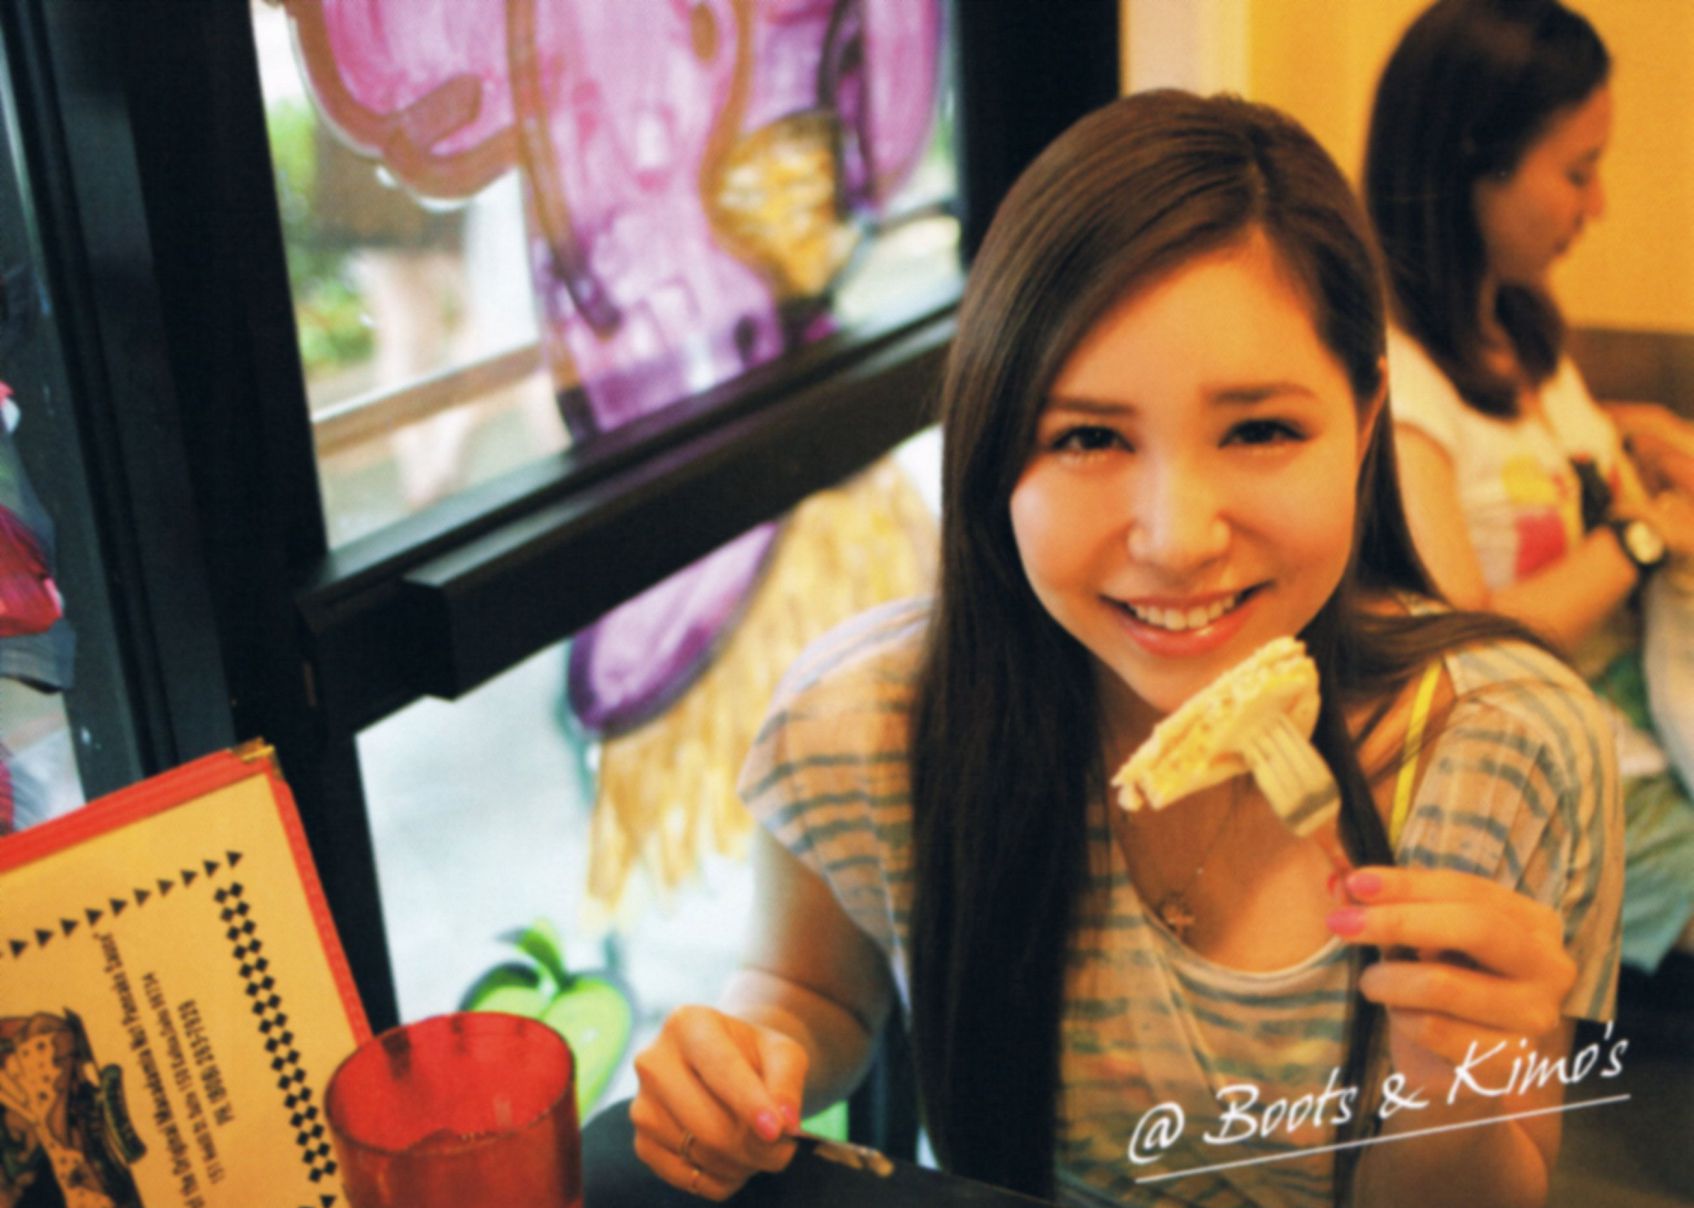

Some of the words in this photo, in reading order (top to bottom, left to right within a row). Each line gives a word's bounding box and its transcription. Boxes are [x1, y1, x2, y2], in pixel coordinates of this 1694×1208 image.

[113, 971, 139, 1026] Pancake
[127, 1025, 148, 1051] Nut
[138, 1048, 173, 1126] Macadamia
[163, 1124, 191, 1176] Original
[181, 1173, 197, 1196] the
